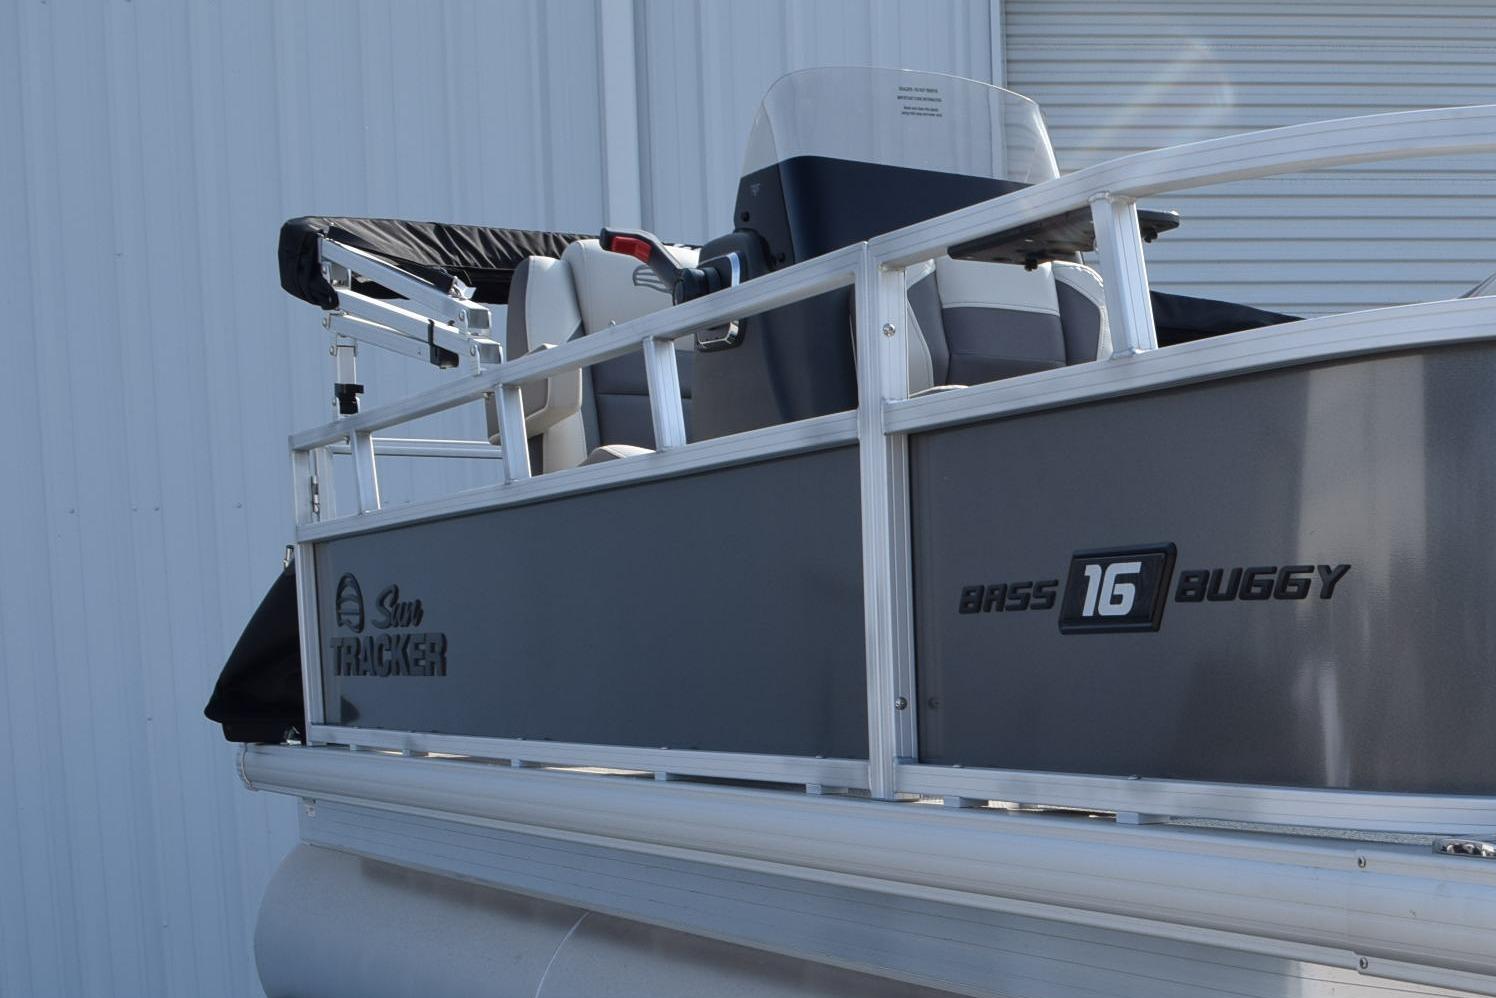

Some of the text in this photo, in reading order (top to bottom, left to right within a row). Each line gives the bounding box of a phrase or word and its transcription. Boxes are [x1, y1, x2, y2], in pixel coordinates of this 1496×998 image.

[370, 583, 424, 629] Sun
[959, 561, 1352, 616] BASS 16 BUGGY
[330, 632, 448, 677] TRACKER
